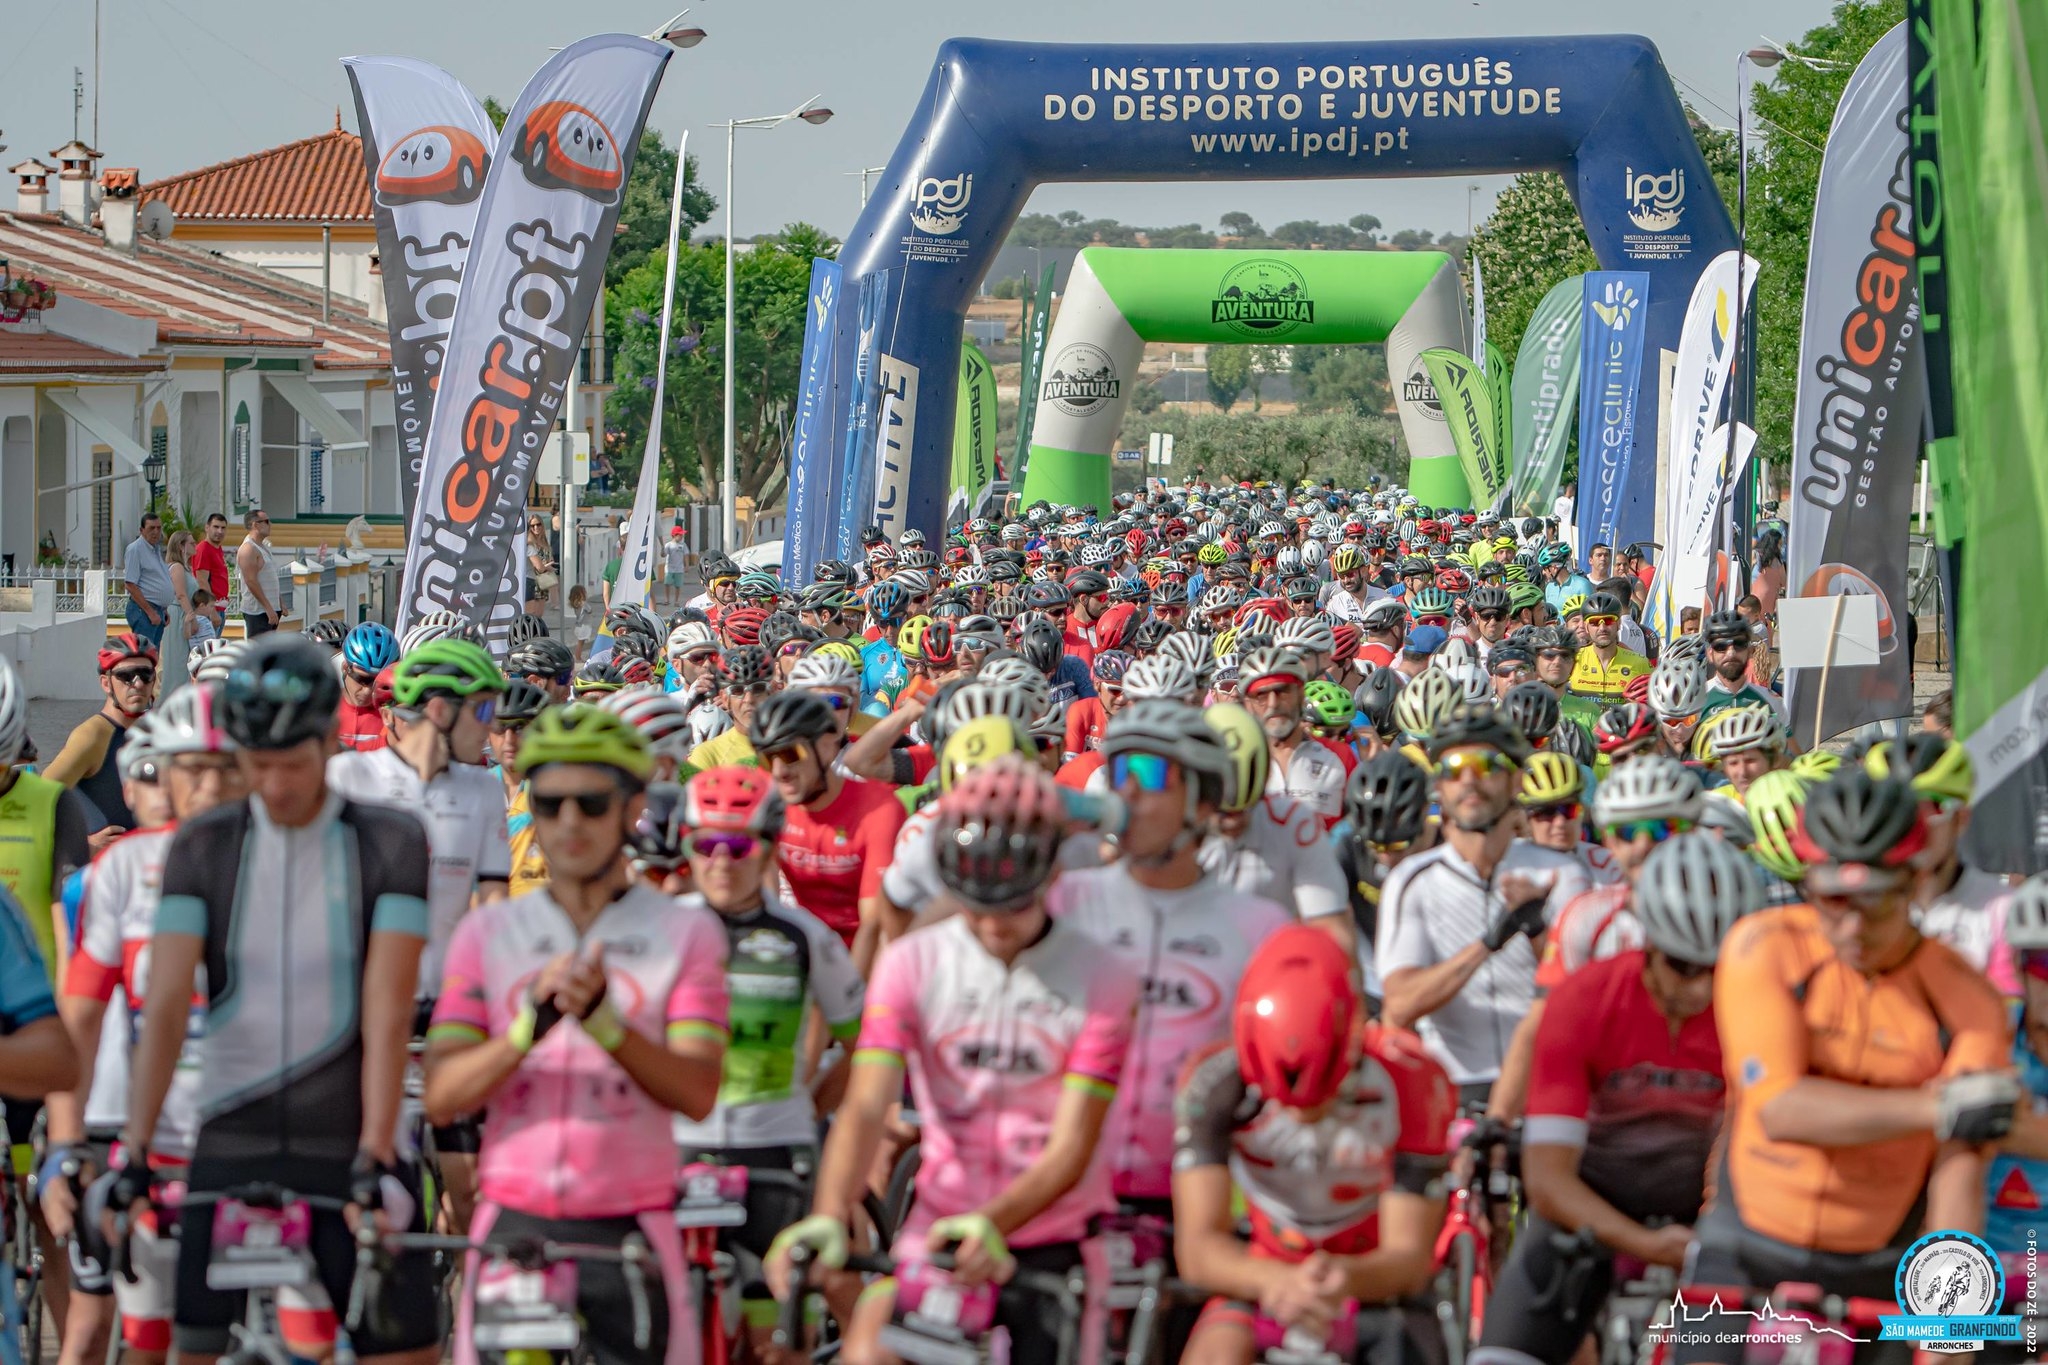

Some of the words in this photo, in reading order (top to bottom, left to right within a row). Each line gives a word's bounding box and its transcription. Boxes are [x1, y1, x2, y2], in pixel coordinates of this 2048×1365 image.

[1091, 66, 1280, 91] INSTITUTO
[1297, 56, 1513, 90] PORTUGUÊS
[1044, 94, 1096, 121] DO
[1113, 93, 1303, 121] DESPORTO
[1320, 93, 1335, 119] E
[1352, 87, 1561, 119] JUVENTUDE
[1190, 126, 1409, 157] www.ipdj.pt
[911, 173, 973, 213] ipdj
[1626, 166, 1686, 209] ipdj
[924, 246, 958, 254] DESPORTO
[934, 237, 970, 246] PORTUGUÊS
[1215, 302, 1311, 322] AVENTURA
[1802, 104, 1916, 512] unicar
[1044, 381, 1118, 400] AVENTURA
[1405, 384, 1439, 401] AVEN
[409, 220, 590, 632] nicarpt
[481, 378, 567, 551] AUTOMÓVEL
[1855, 405, 1888, 509] GESTÃO
